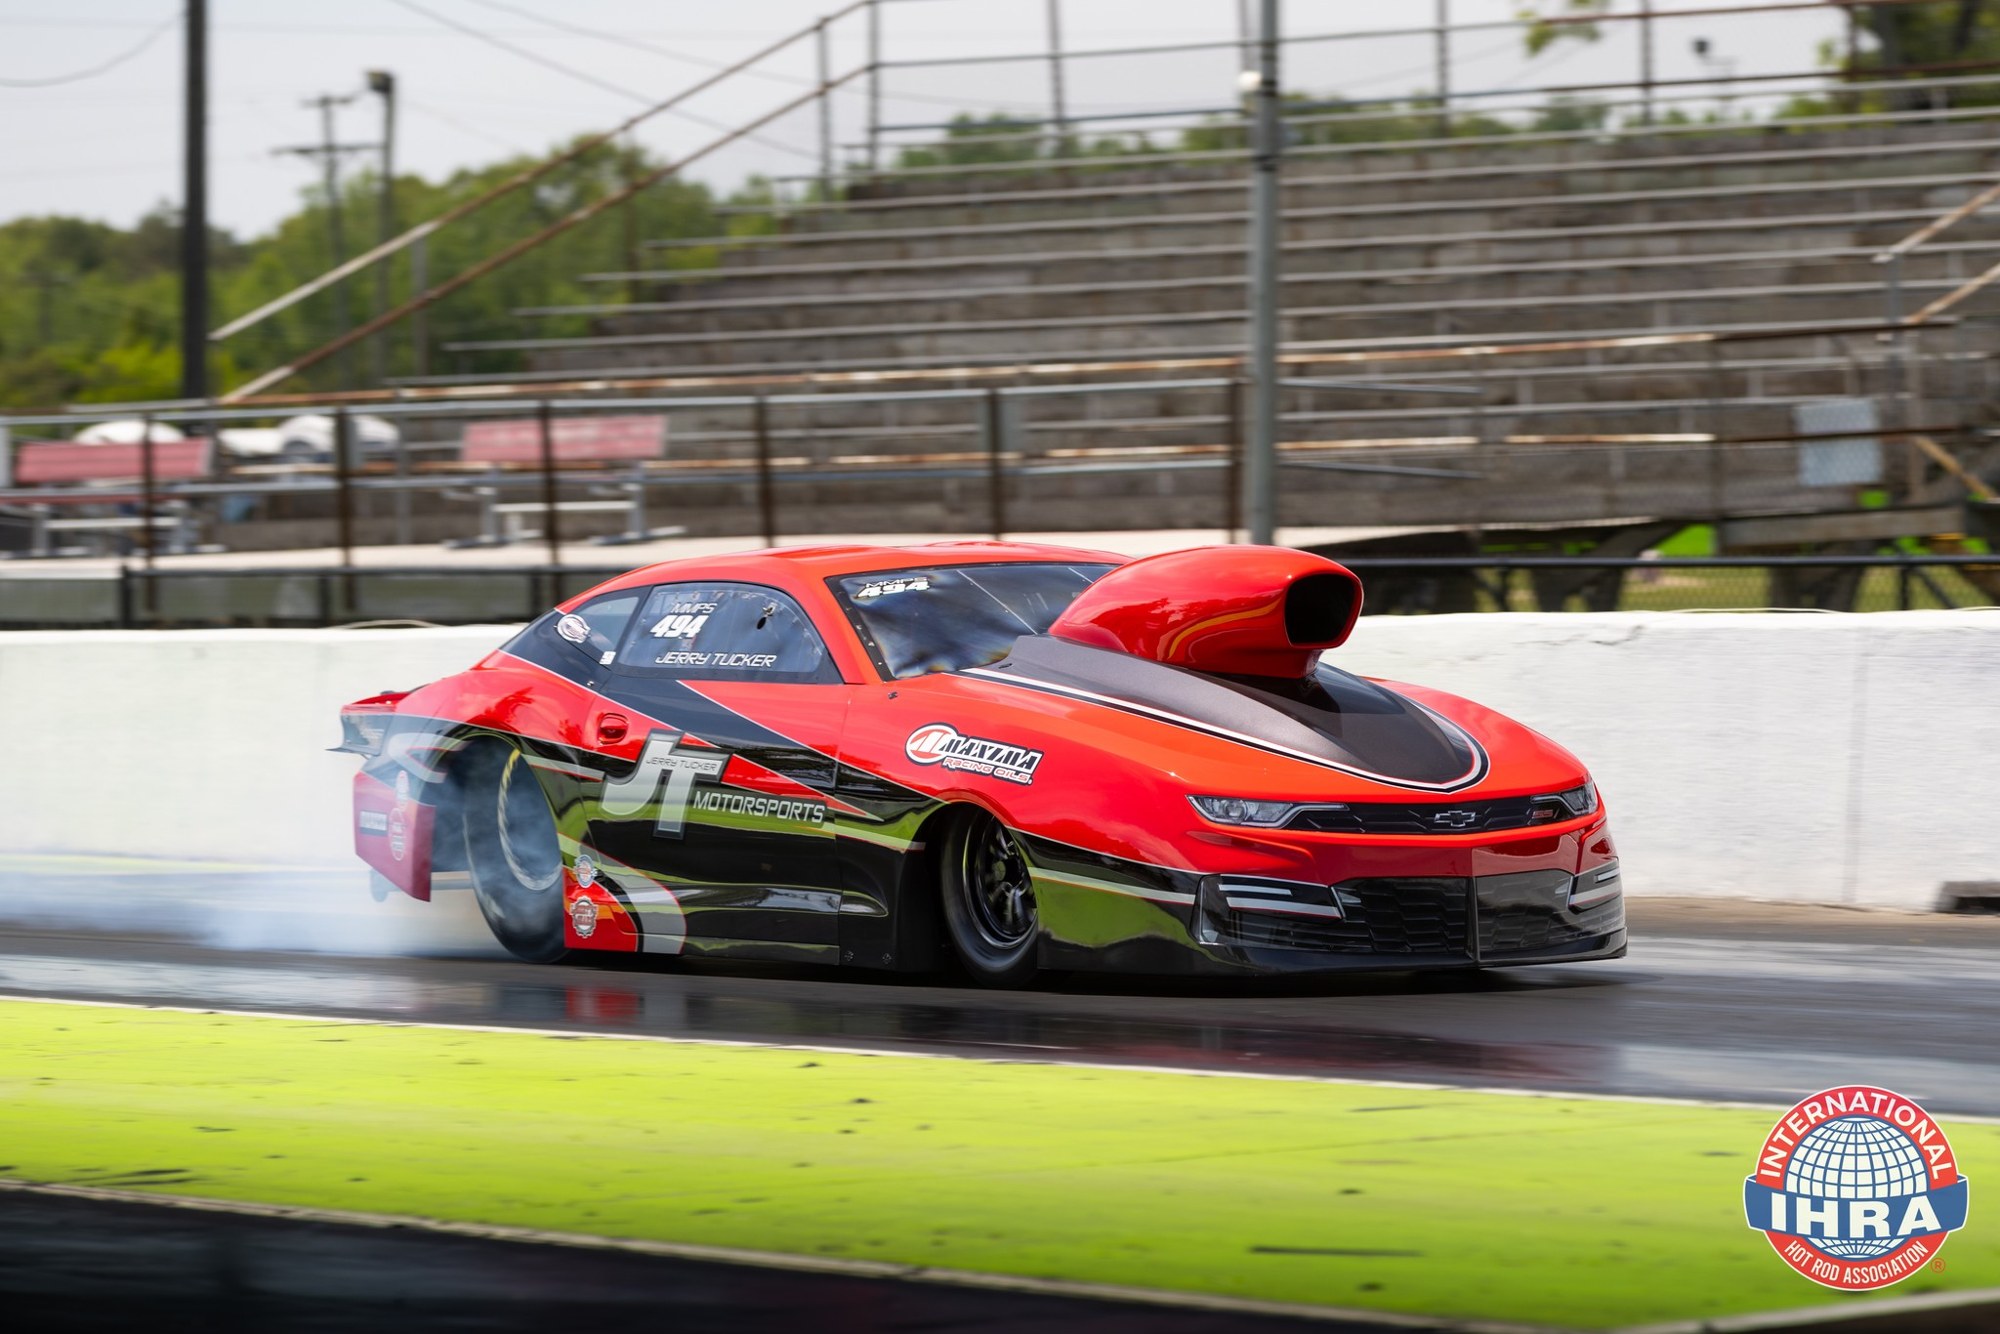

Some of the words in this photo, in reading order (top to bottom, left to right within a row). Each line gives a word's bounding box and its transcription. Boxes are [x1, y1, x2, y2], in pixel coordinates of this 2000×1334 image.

[858, 581, 930, 597] 494
[670, 603, 717, 613] MMPS
[650, 614, 709, 638] 494
[655, 652, 710, 664] JERRY
[711, 653, 777, 667] TUCKER
[646, 757, 677, 767] JERRY
[680, 760, 717, 771] TUCKER
[944, 758, 992, 774] RACING
[693, 791, 825, 823] MOTORSPORTS
